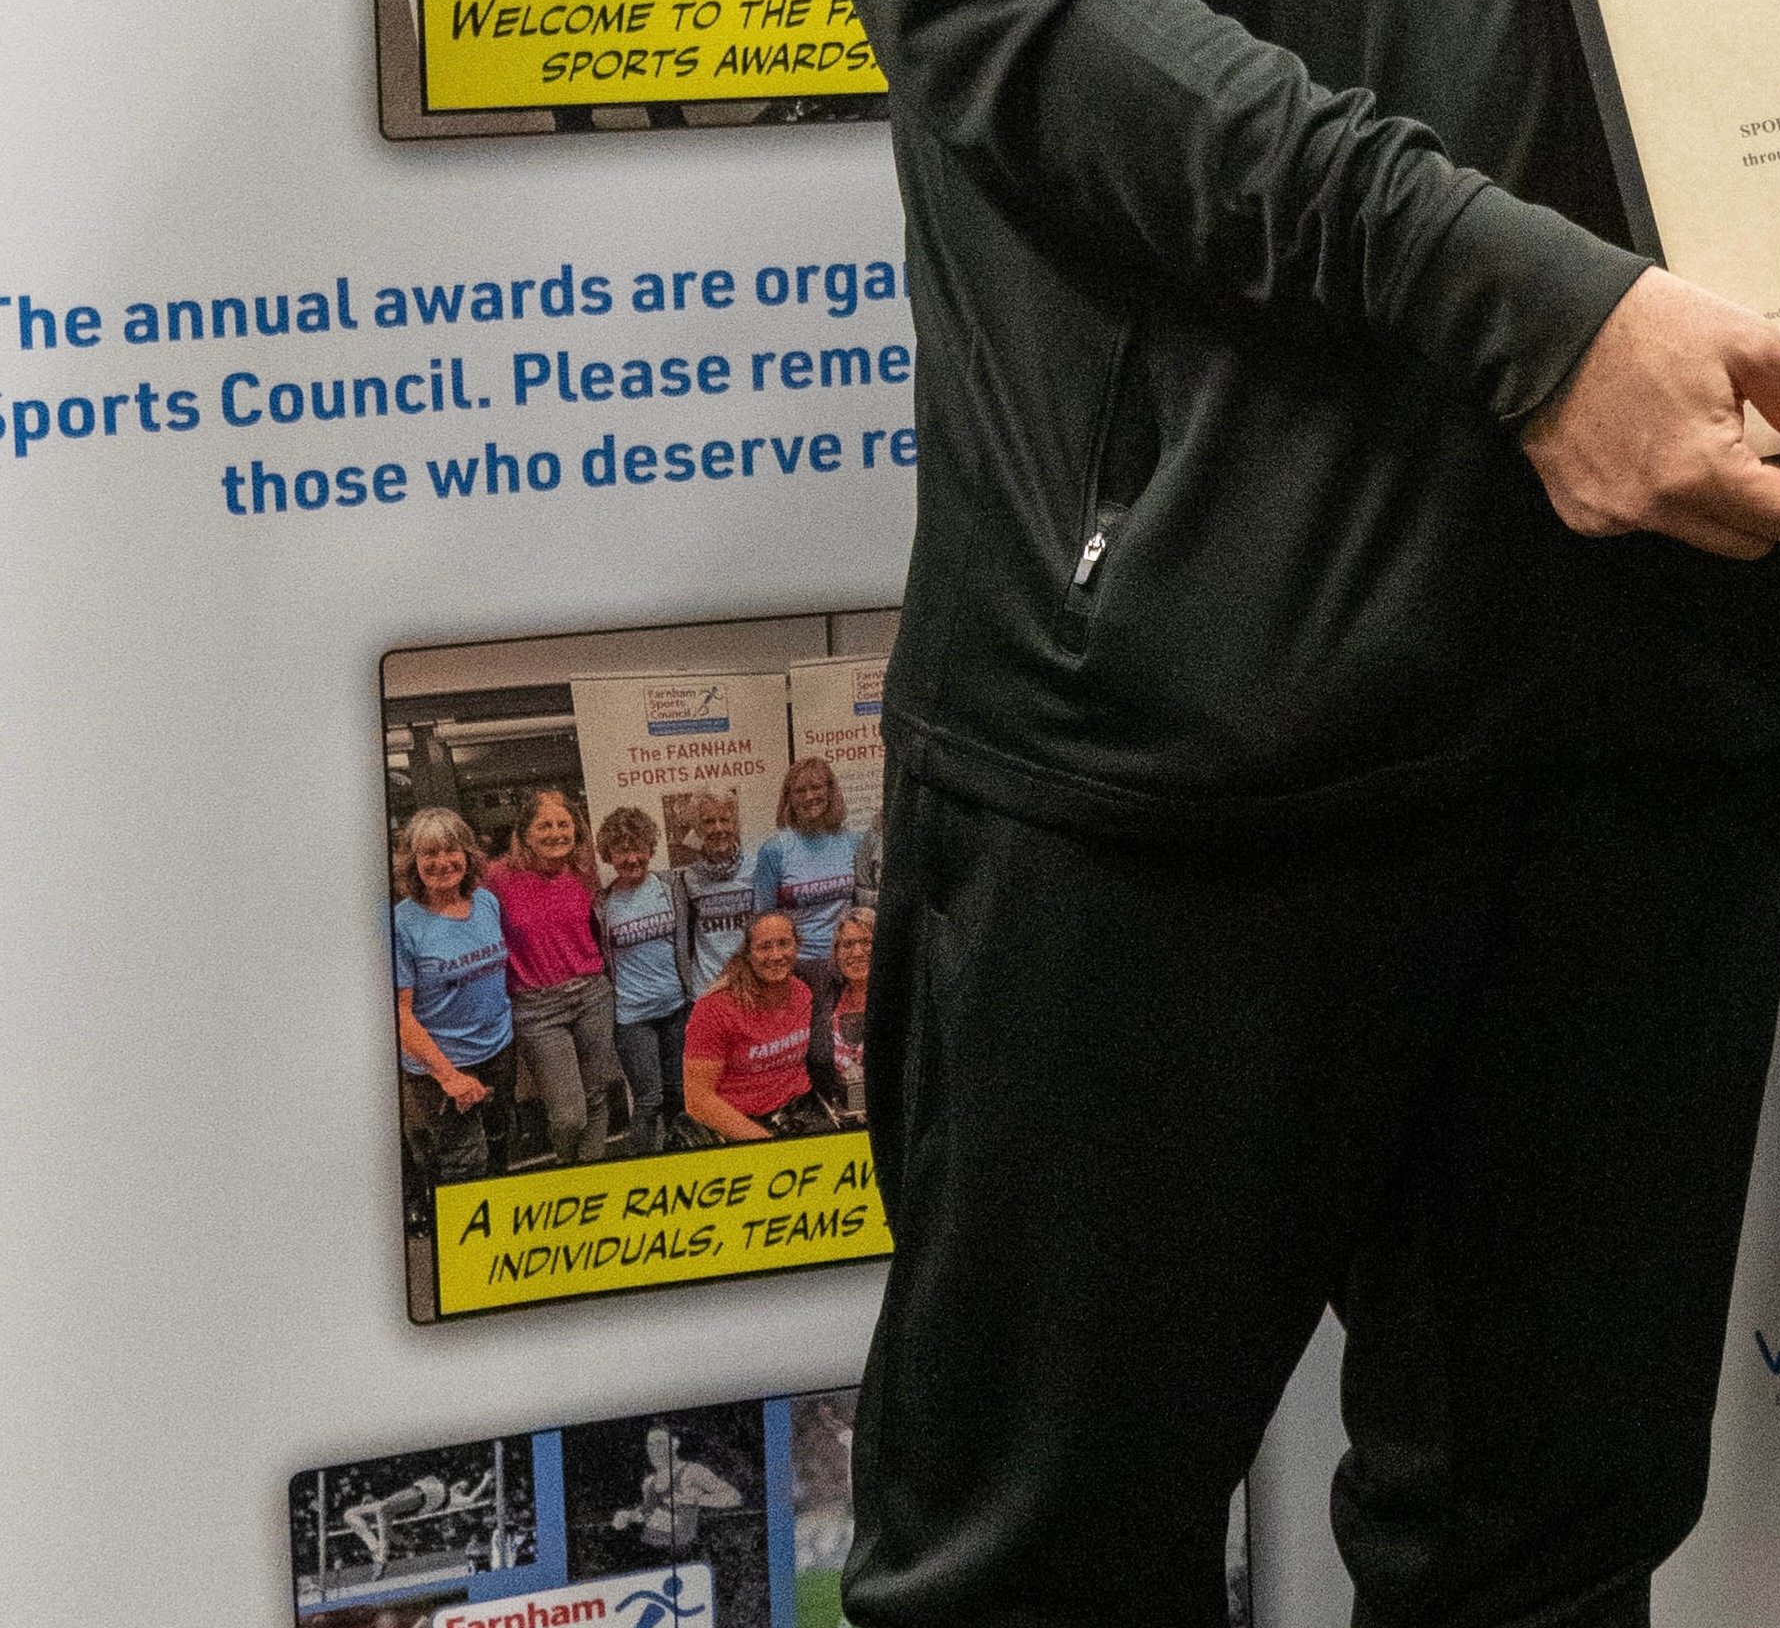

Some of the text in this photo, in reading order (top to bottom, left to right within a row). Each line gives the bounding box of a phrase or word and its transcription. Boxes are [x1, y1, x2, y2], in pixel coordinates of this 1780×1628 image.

[672, 0, 722, 32] TO
[543, 46, 699, 83] SPORTS
[123, 277, 359, 345] annual
[374, 264, 614, 329] awards
[631, 270, 736, 312] are
[0, 380, 200, 459] ports
[220, 358, 491, 429] Council.
[512, 343, 731, 407] Please
[222, 451, 408, 517] those
[427, 440, 562, 500] who
[581, 426, 843, 487] deserve
[627, 739, 751, 763] The FARNHAM
[805, 723, 867, 747] Support
[617, 759, 766, 787] SPORTS AWARDS
[460, 1163, 823, 1245] A WIDE RANGE OF
[489, 1205, 869, 1285] INDIVIDUALS, TEAMS
